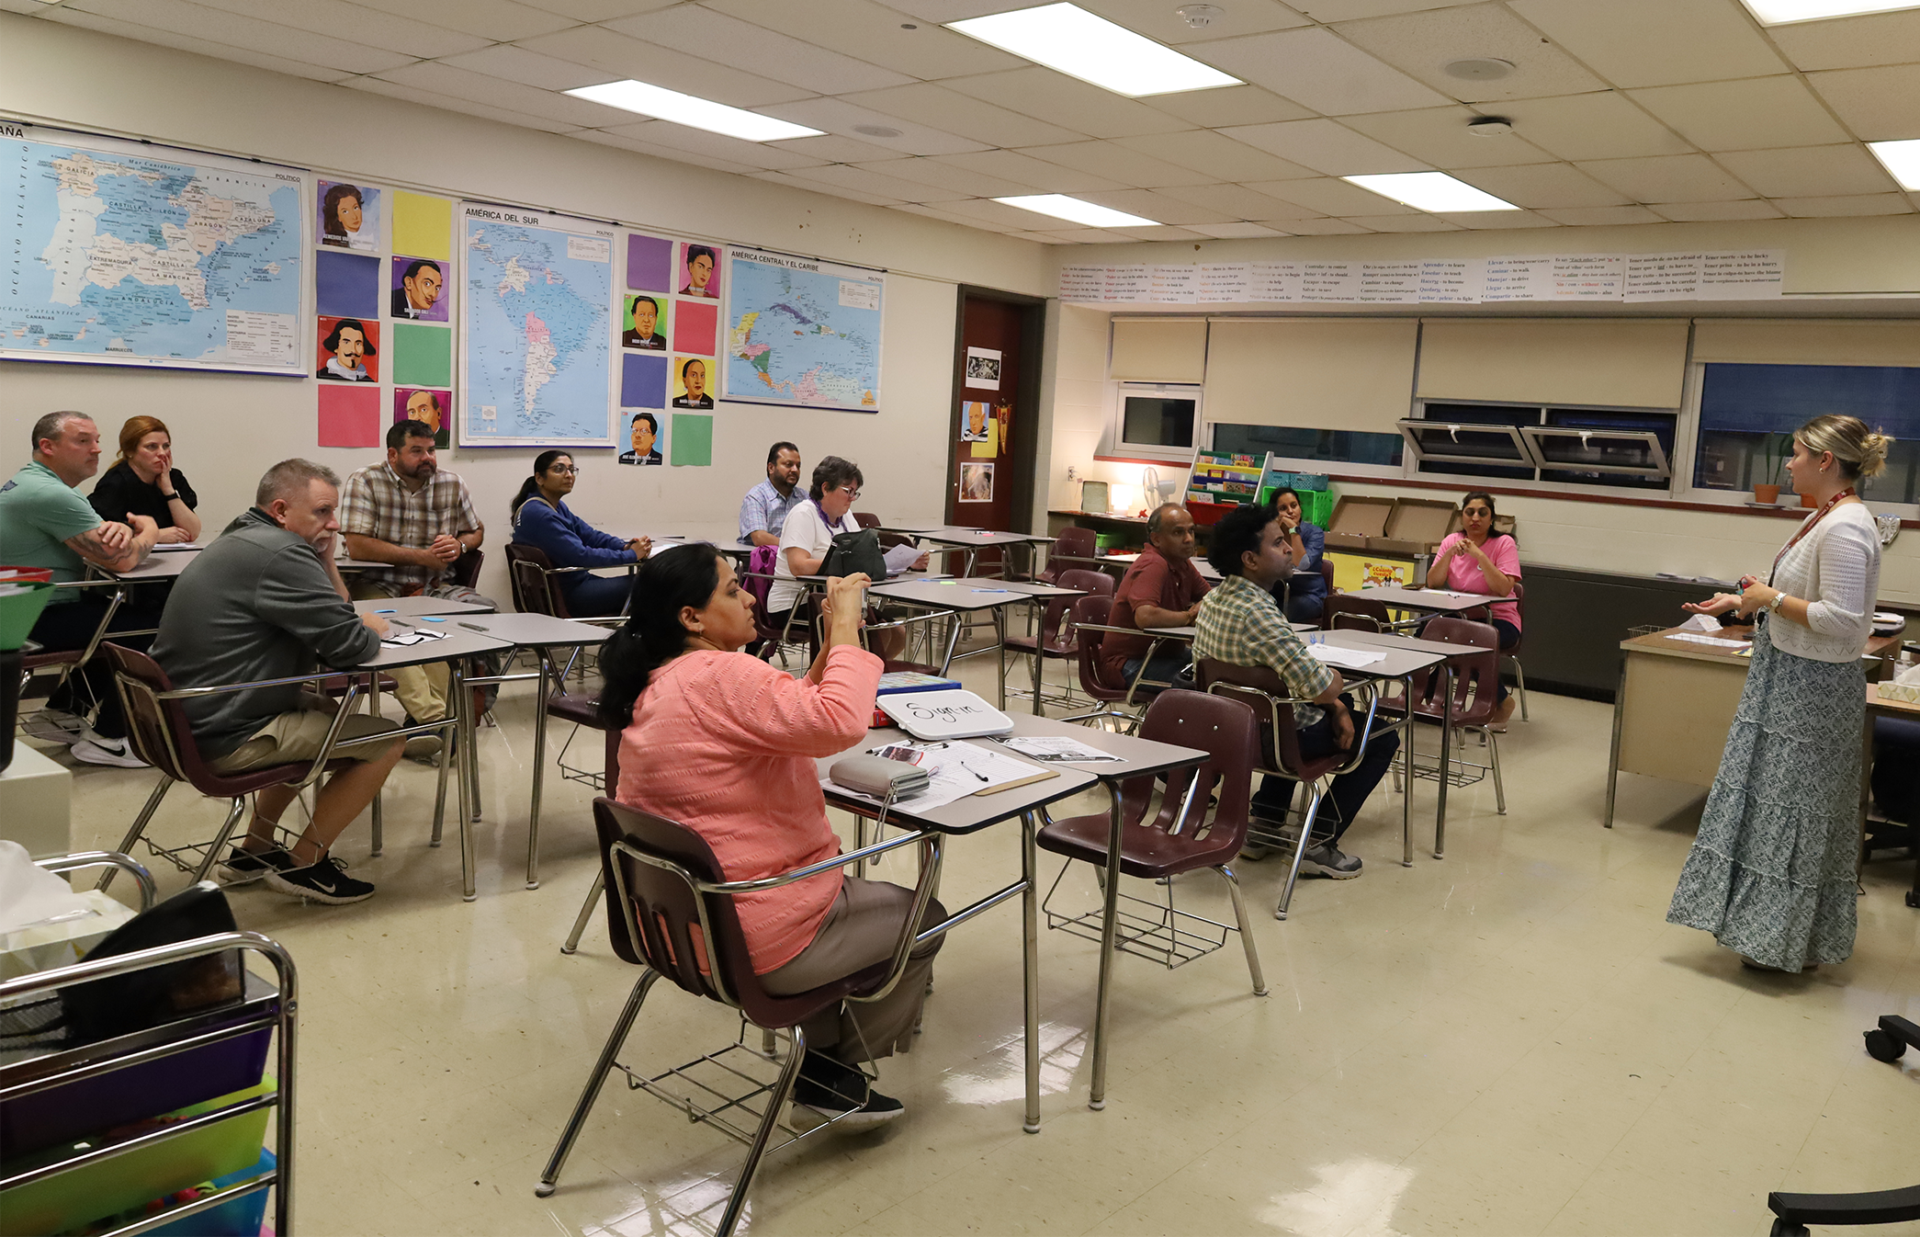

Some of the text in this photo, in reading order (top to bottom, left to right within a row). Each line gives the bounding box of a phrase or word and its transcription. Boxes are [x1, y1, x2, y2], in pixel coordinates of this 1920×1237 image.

[66, 166, 94, 176] GALICIA
[276, 173, 300, 182] POLÍTICO
[109, 201, 142, 210] CASTILLA
[466, 208, 539, 225] AMÉRICA DEL SUR
[90, 256, 132, 266] EXTREMADURA
[731, 250, 758, 260] AMÉRICA
[758, 254, 785, 265] CENTRAL
[798, 262, 819, 271] CARIBE
[122, 296, 174, 306] ANDALUCÍA
[906, 702, 984, 723] Sign-in
